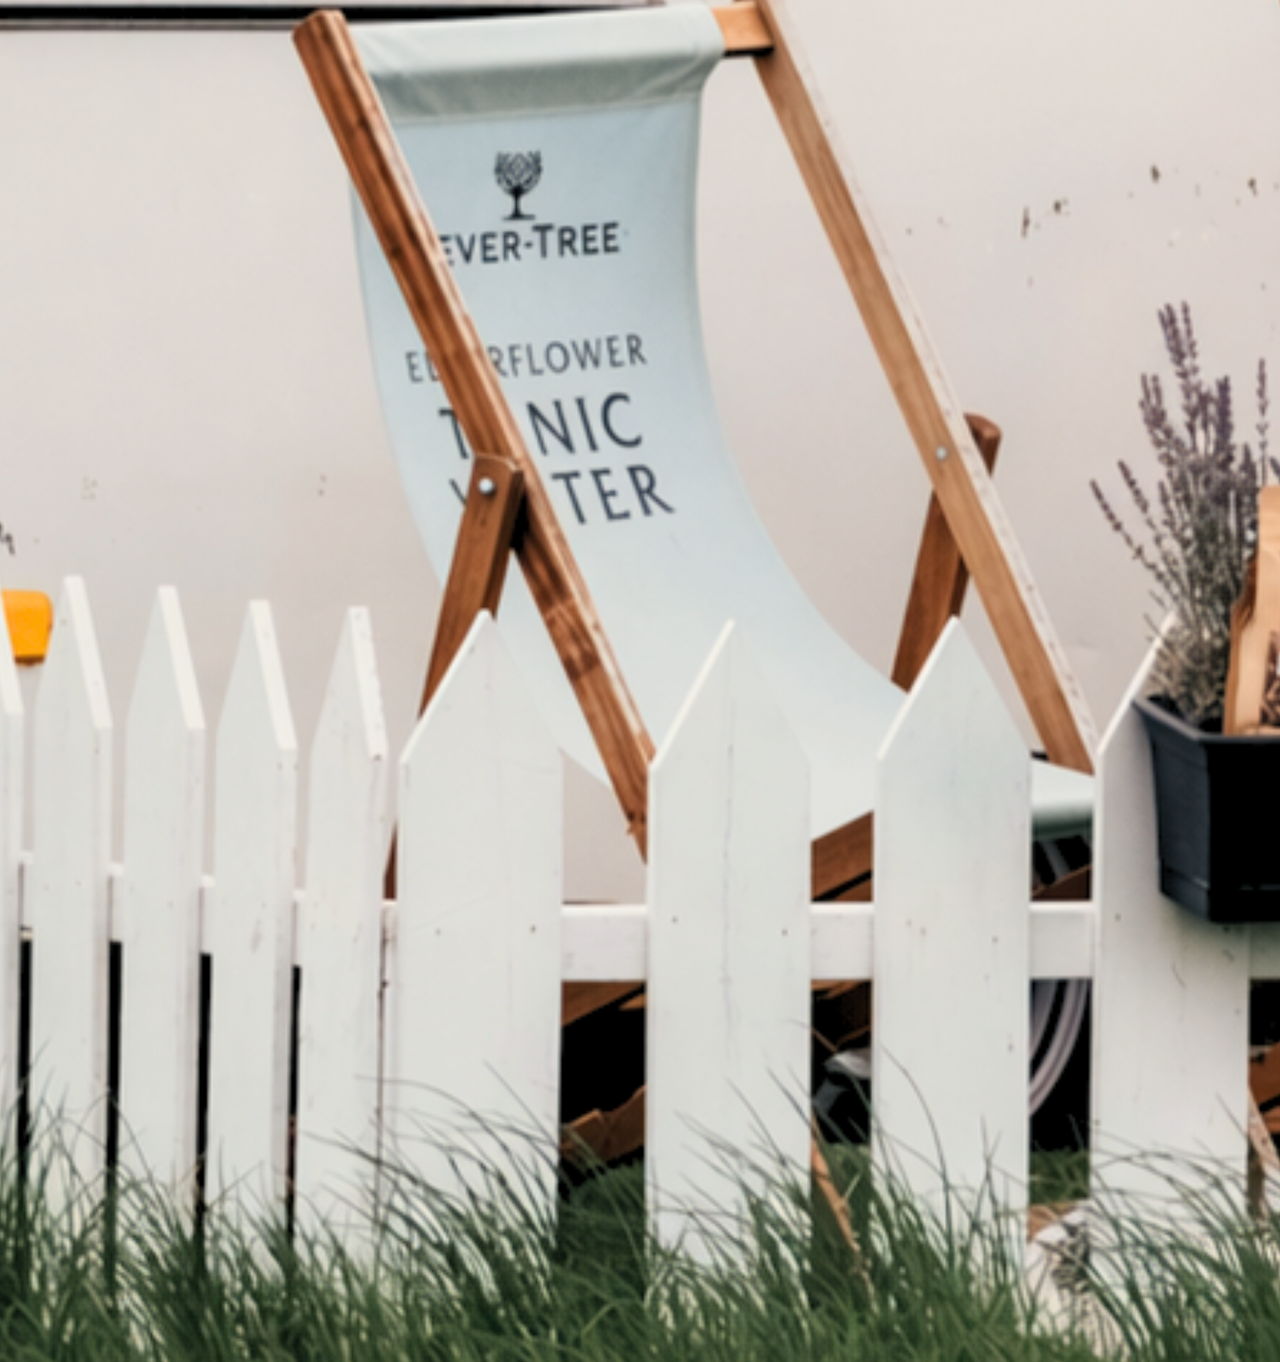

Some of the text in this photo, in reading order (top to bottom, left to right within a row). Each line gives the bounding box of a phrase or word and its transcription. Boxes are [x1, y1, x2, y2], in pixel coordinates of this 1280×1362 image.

[438, 220, 620, 266] EVER-TREE
[405, 334, 647, 383] ELRFLOWER
[438, 392, 643, 460] TNIC
[449, 464, 675, 526] TER
